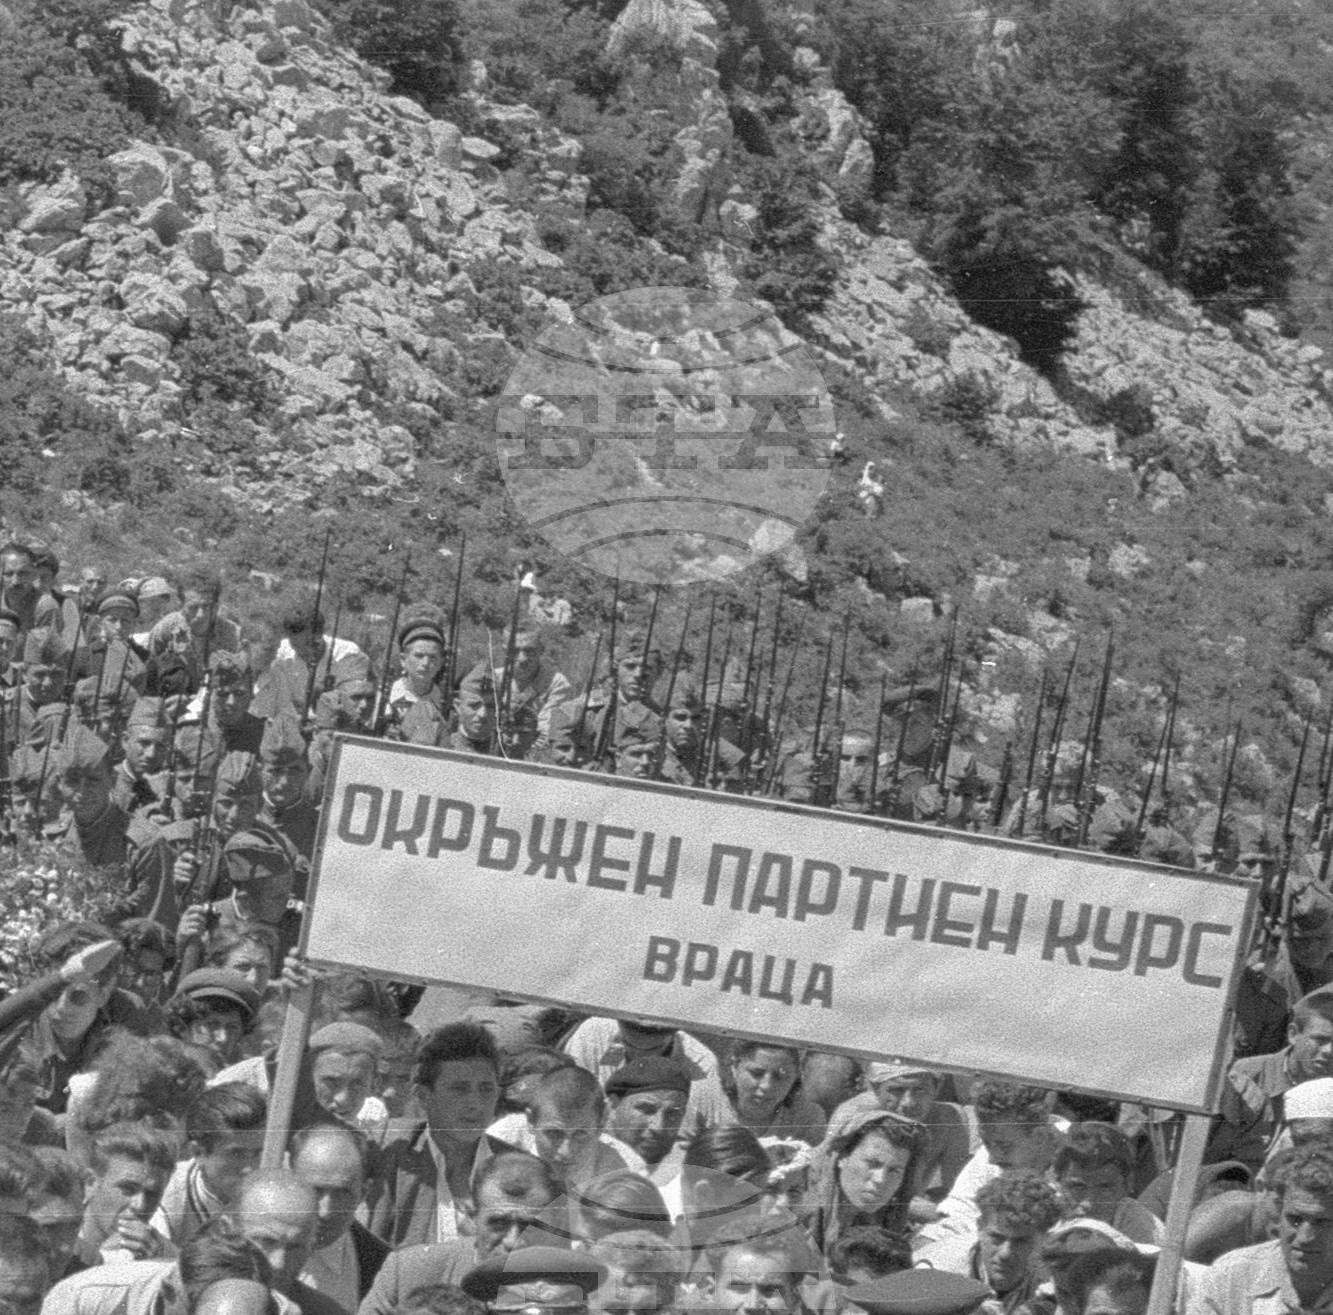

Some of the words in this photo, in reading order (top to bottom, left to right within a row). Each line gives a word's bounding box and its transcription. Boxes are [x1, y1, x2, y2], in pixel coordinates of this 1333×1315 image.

[336, 782, 683, 899] ОКРЪЖЕН
[702, 843, 1028, 956] ПАРТИЕН
[1041, 899, 1235, 989] КУРС
[642, 935, 833, 1009] ВРАЦА
